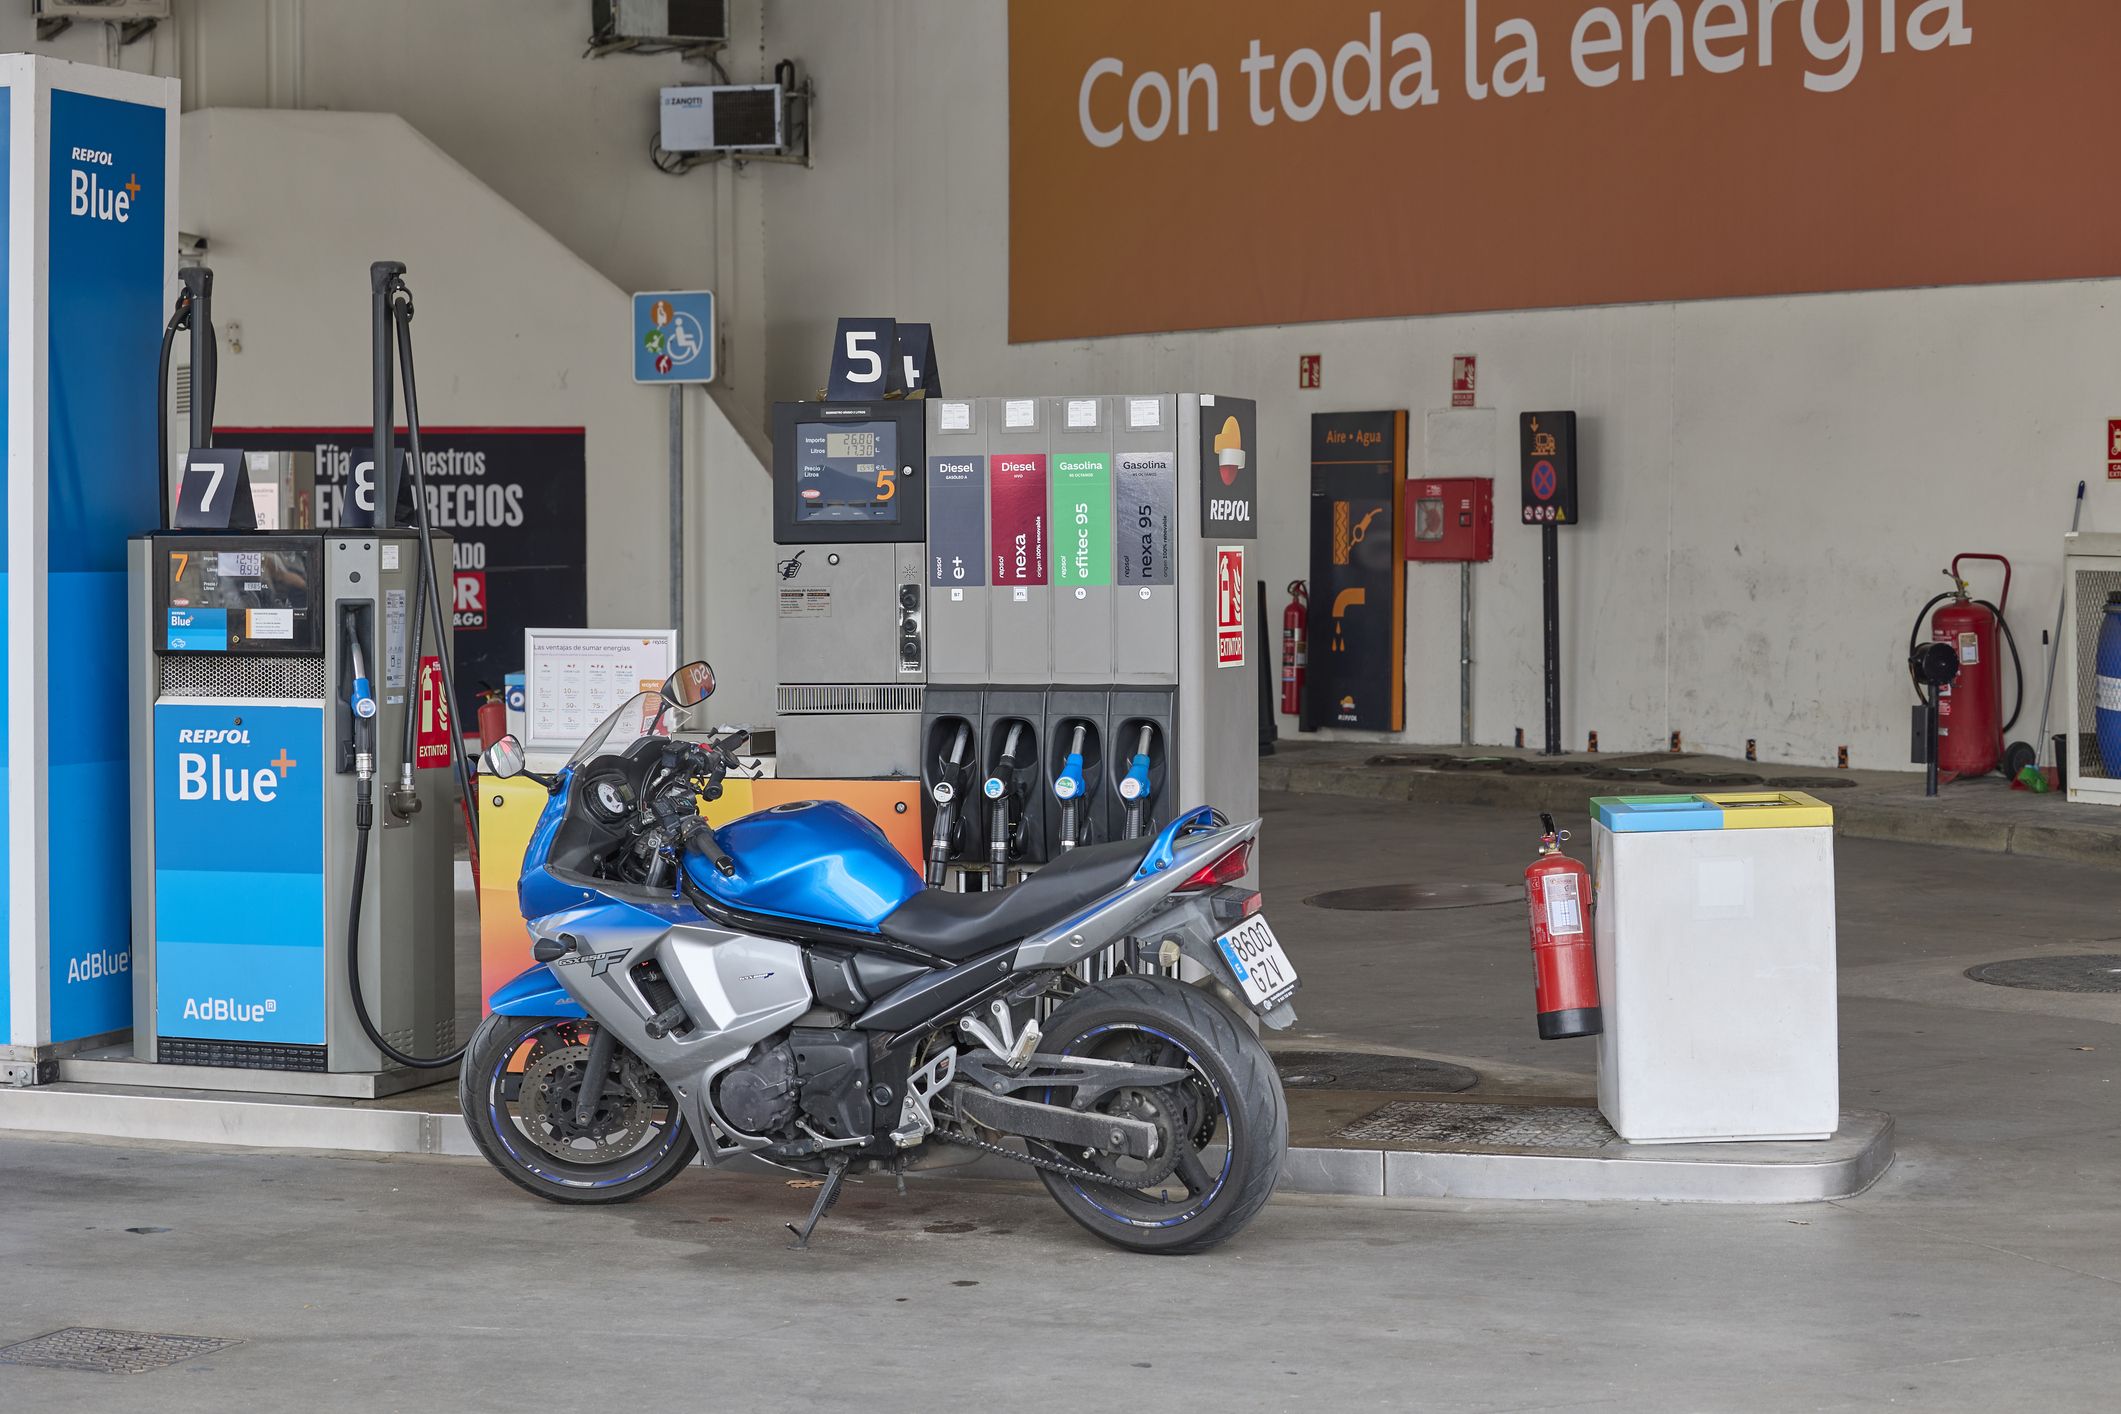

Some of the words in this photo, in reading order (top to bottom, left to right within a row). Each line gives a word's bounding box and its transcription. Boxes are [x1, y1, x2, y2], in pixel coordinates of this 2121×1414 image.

[1078, 57, 1219, 149] Con
[1240, 11, 1439, 126] toda
[1463, 0, 1545, 101] la
[671, 97, 703, 105] ZANOTTI
[71, 146, 113, 166] REPSOL
[845, 331, 882, 383] 5
[1326, 430, 1346, 443] Aire
[1356, 430, 1382, 447] Agua
[315, 444, 352, 482] Fíja
[939, 462, 973, 473] Diesel
[1001, 461, 1036, 472] Diesel
[1059, 461, 1103, 471] Gasolina
[1123, 460, 1167, 470] Gasolina
[190, 463, 225, 512] 7
[876, 470, 896, 500] 5
[1075, 502, 1088, 525] 95
[1139, 504, 1152, 528] 95
[1210, 499, 1250, 522] REPSOL
[453, 542, 486, 569] ADO
[1016, 533, 1026, 579] nexa
[1075, 529, 1089, 578] efitec
[1140, 533, 1153, 578] nexa
[171, 553, 189, 582] 7
[952, 556, 965, 580] e+
[1220, 638, 1241, 657] EXTINTOR
[179, 729, 250, 744] REPSOL
[419, 744, 448, 757] EXTINTOR
[1231, 921, 1273, 962] 8600
[67, 947, 131, 984] AdBlue
[1234, 963, 1243, 974] E
[1250, 954, 1285, 994] GZV
